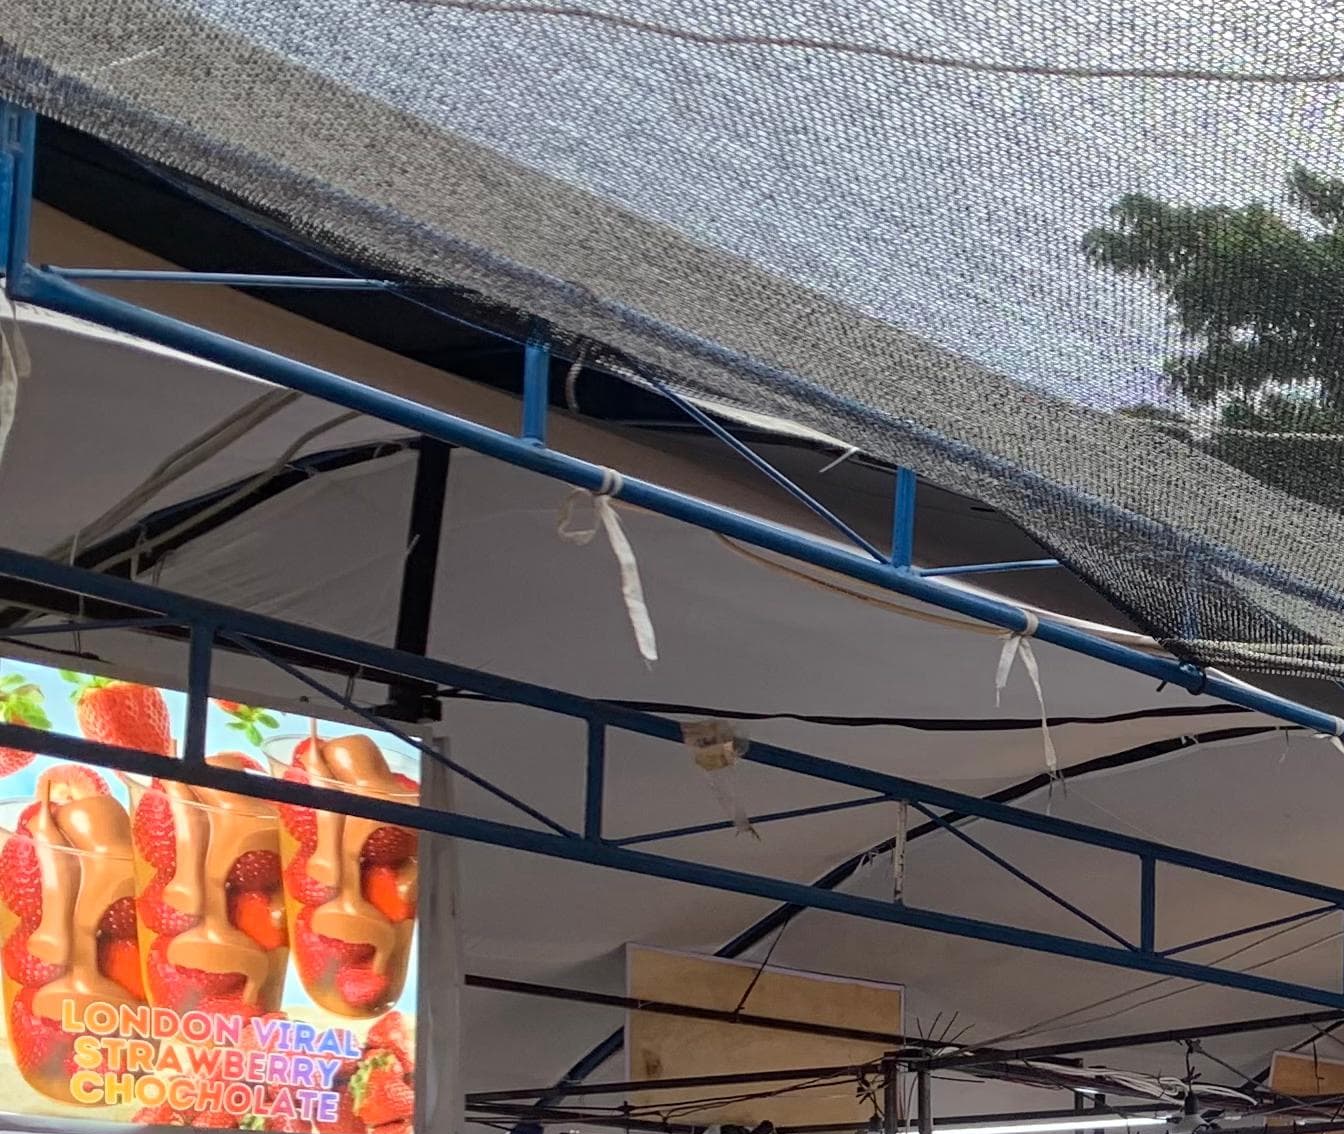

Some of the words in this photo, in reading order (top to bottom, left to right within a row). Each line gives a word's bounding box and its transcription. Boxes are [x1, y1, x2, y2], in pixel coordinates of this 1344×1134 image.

[62, 999, 241, 1046] LONDON
[250, 1017, 361, 1058] VIRAL
[73, 1036, 340, 1089] STRAWBERRY
[70, 1070, 339, 1123] CHOCHOLATE
